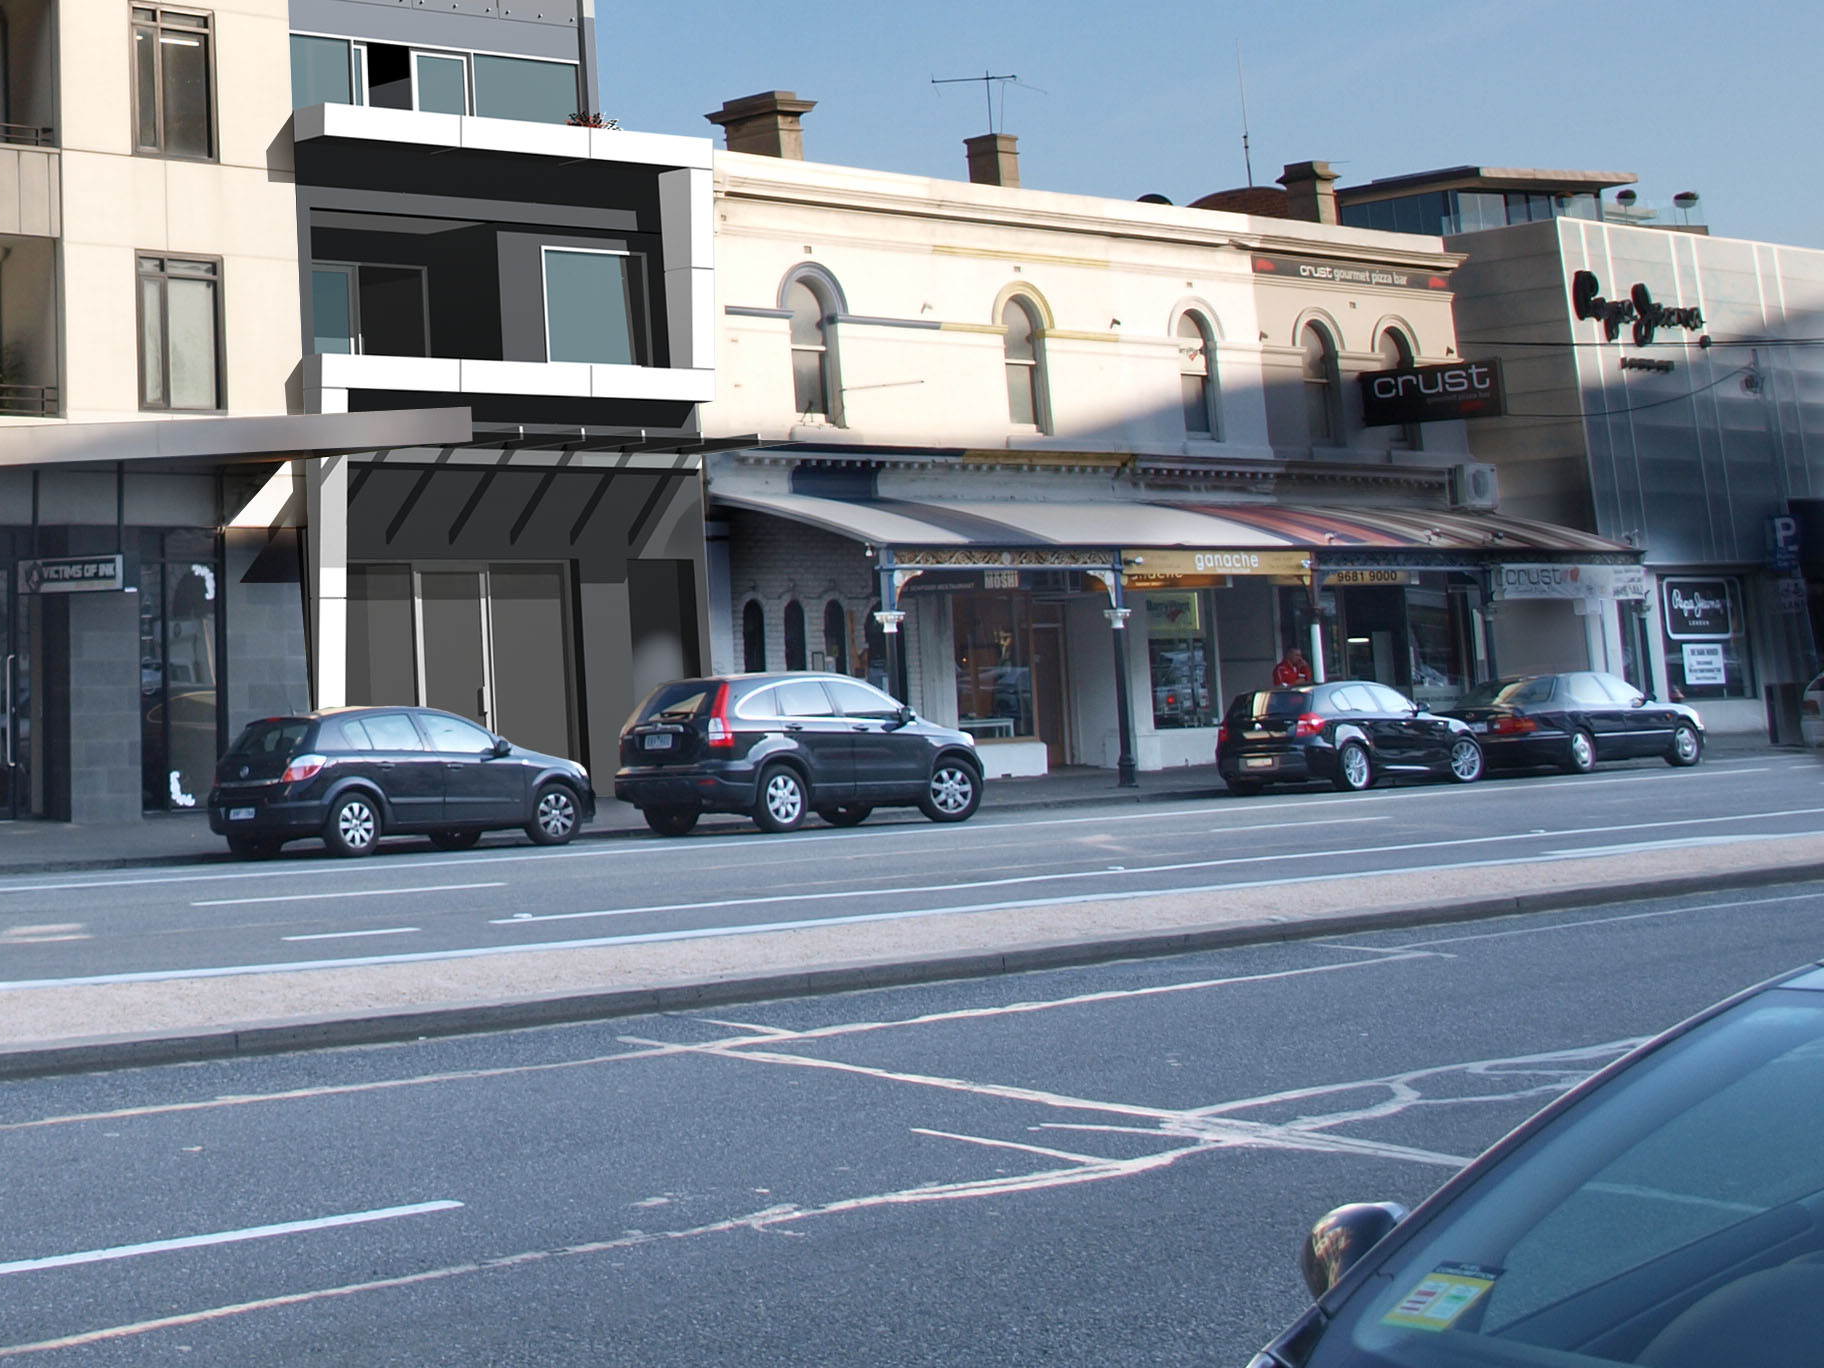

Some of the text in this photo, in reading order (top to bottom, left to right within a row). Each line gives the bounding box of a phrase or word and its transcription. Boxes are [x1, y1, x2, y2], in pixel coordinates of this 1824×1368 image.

[1299, 264, 1408, 285] crust gourmet pizza bar
[1373, 364, 1491, 399] crust
[1774, 517, 1796, 548] P
[1194, 551, 1260, 571] ganache
[42, 563, 116, 580] VICTIMS OF INK
[1337, 570, 1398, 582] 9681 9000
[1505, 566, 1562, 586] crust
[984, 575, 1019, 590] MOSHI
